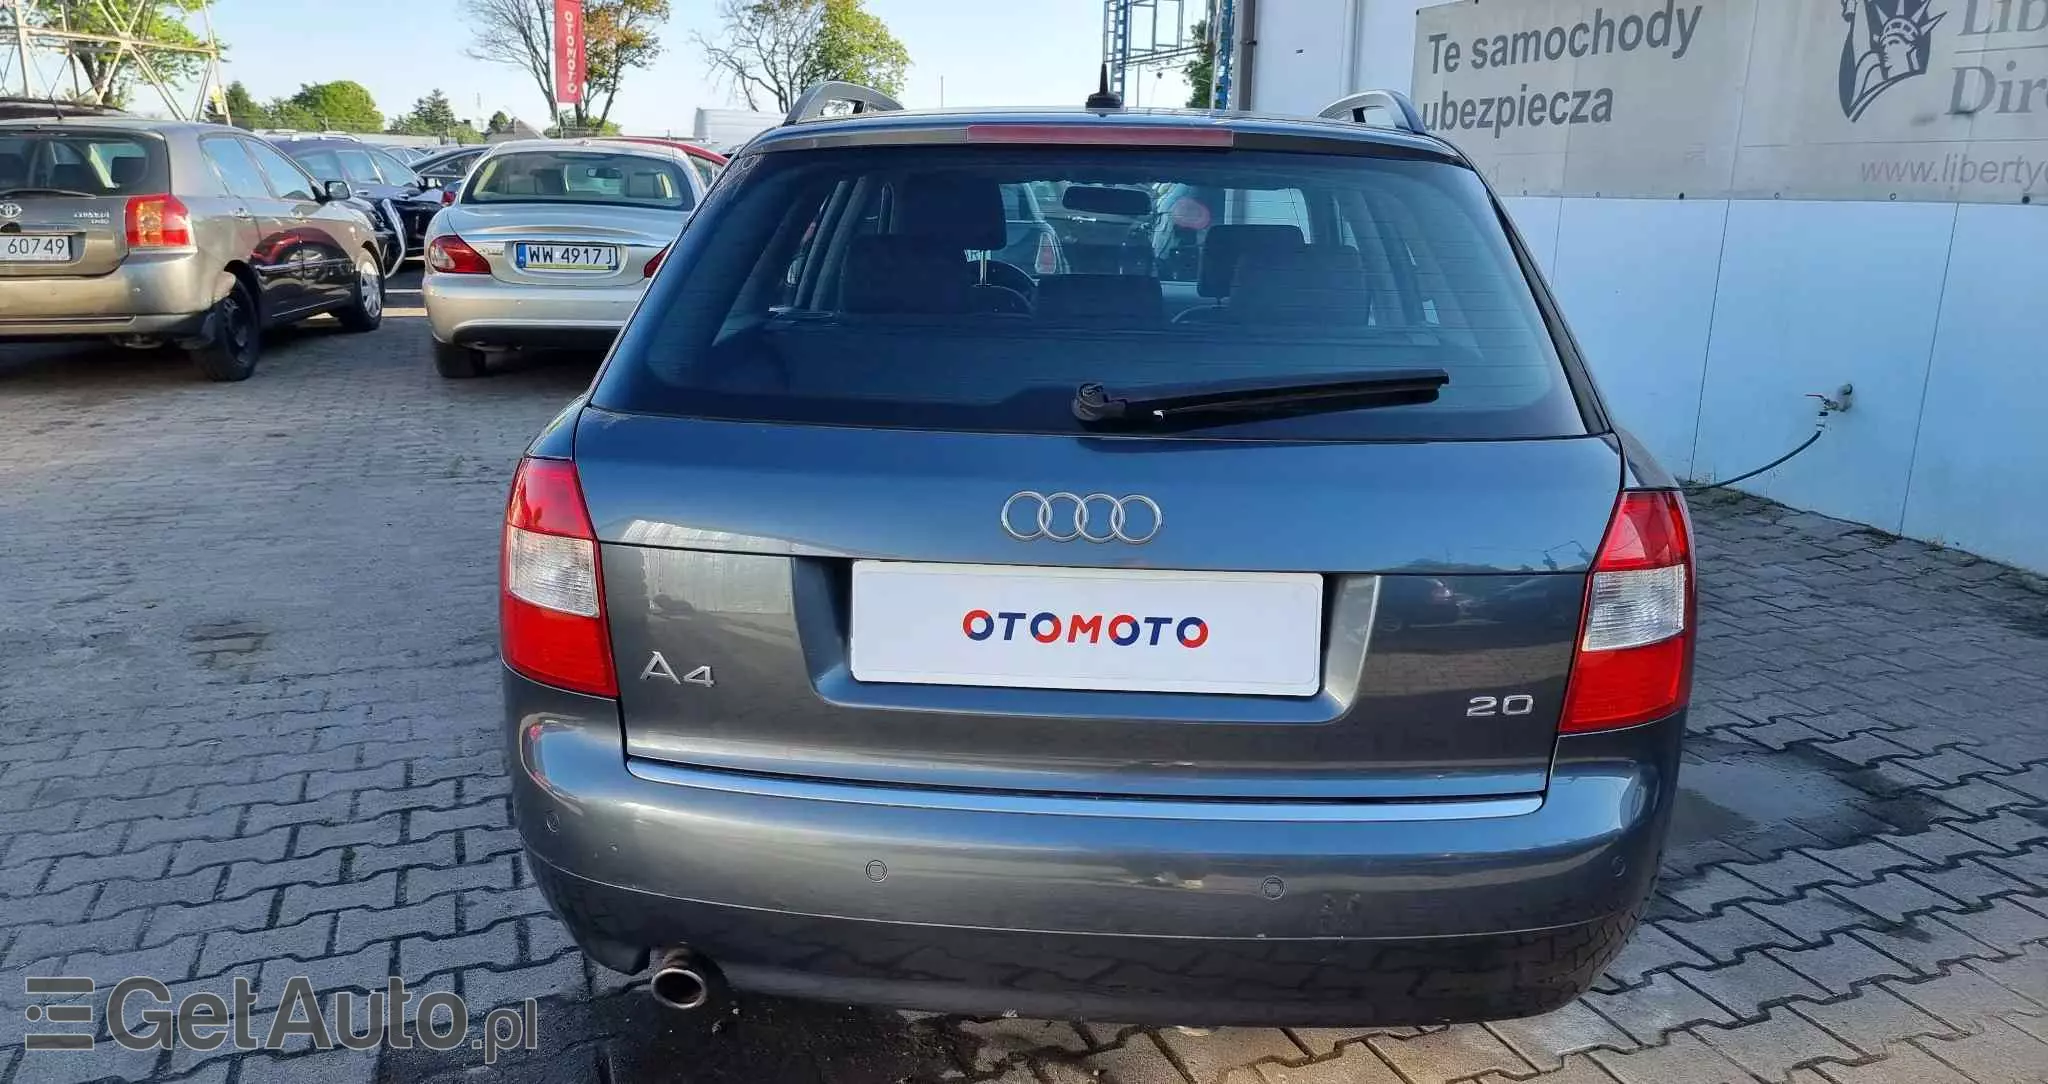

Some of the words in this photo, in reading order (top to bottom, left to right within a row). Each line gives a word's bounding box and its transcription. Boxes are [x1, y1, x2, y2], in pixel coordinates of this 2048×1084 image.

[564, 11, 577, 94] OTOMOTO
[1429, 33, 1461, 74] Te
[1471, 0, 1702, 69] samochody
[1944, 61, 2048, 115] Dir
[1423, 84, 1614, 139] ubezpiecza
[1861, 153, 2048, 191] www.liberty
[7, 239, 65, 254] 60749
[528, 247, 553, 263] WW
[561, 248, 612, 265] 4917J
[963, 610, 1209, 648] OTOMOTO
[640, 651, 714, 687] A4
